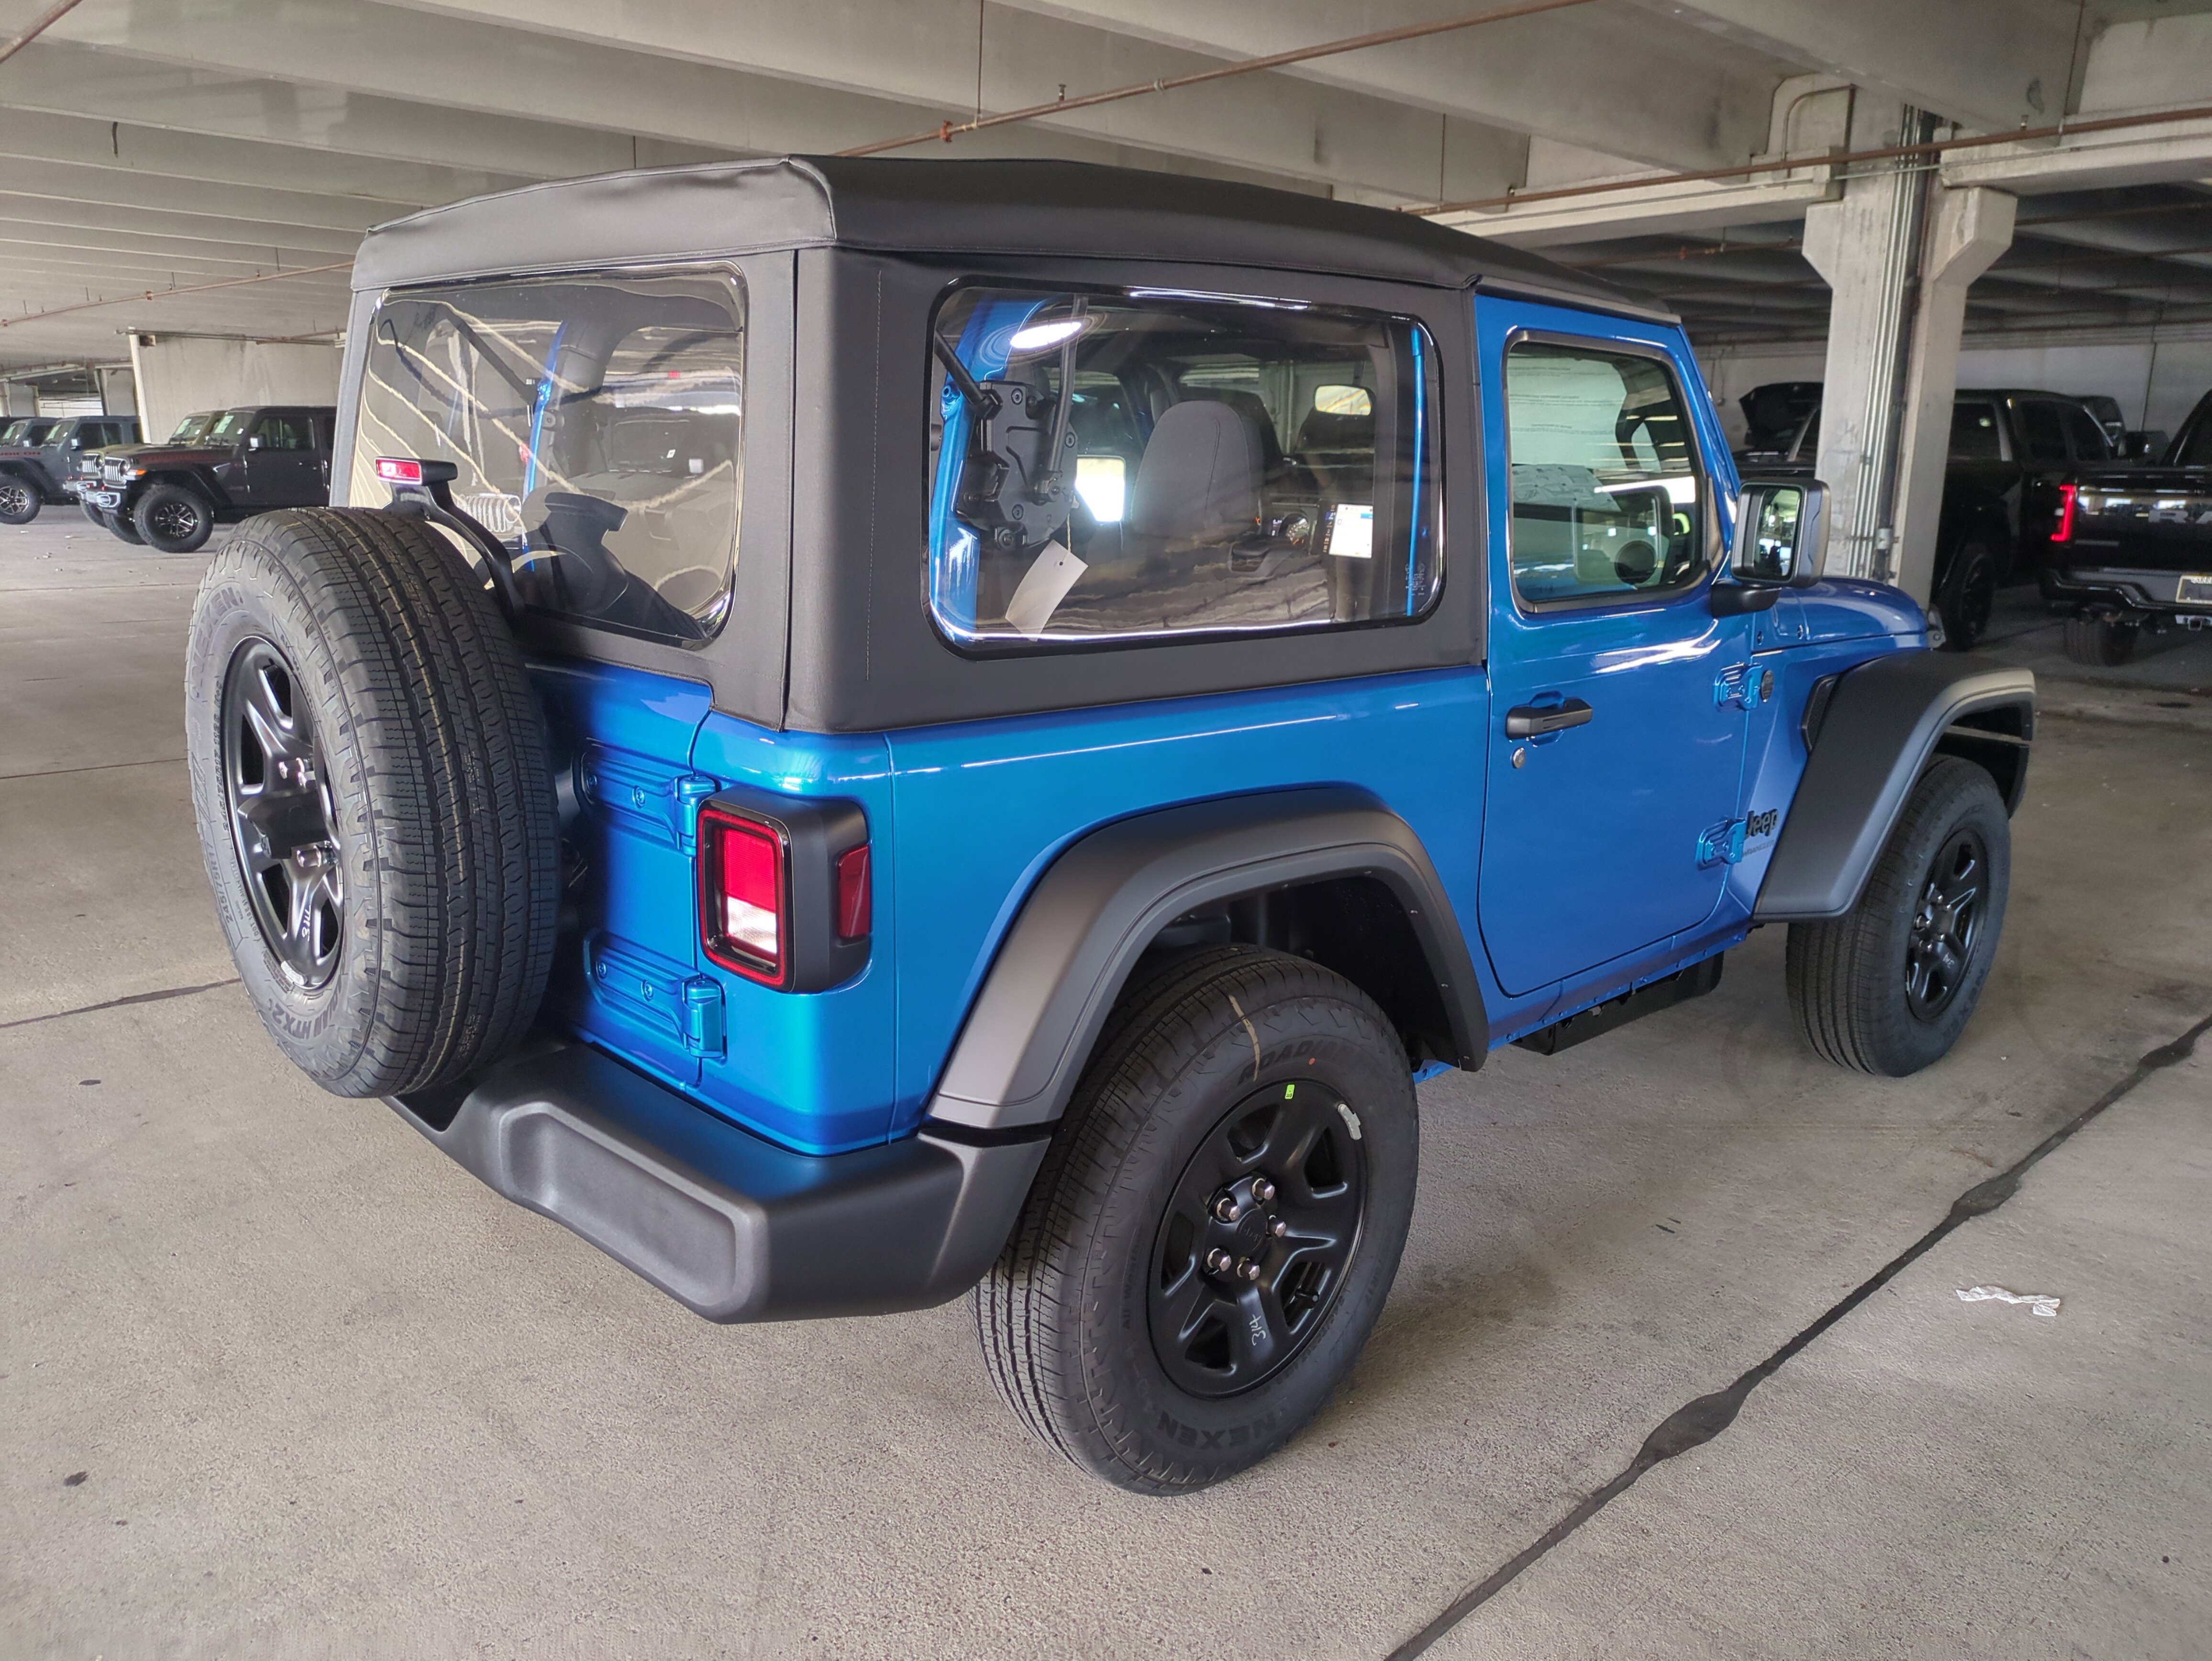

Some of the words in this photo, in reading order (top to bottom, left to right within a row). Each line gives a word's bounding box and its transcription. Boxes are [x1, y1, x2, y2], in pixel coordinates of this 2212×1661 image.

[192, 587, 239, 687] NEXEN
[1745, 808, 1778, 839] Jeep
[206, 841, 233, 923] 245/75R17
[272, 1003, 312, 1040] HTX2
[1158, 1410, 1276, 1451] NEXEN
